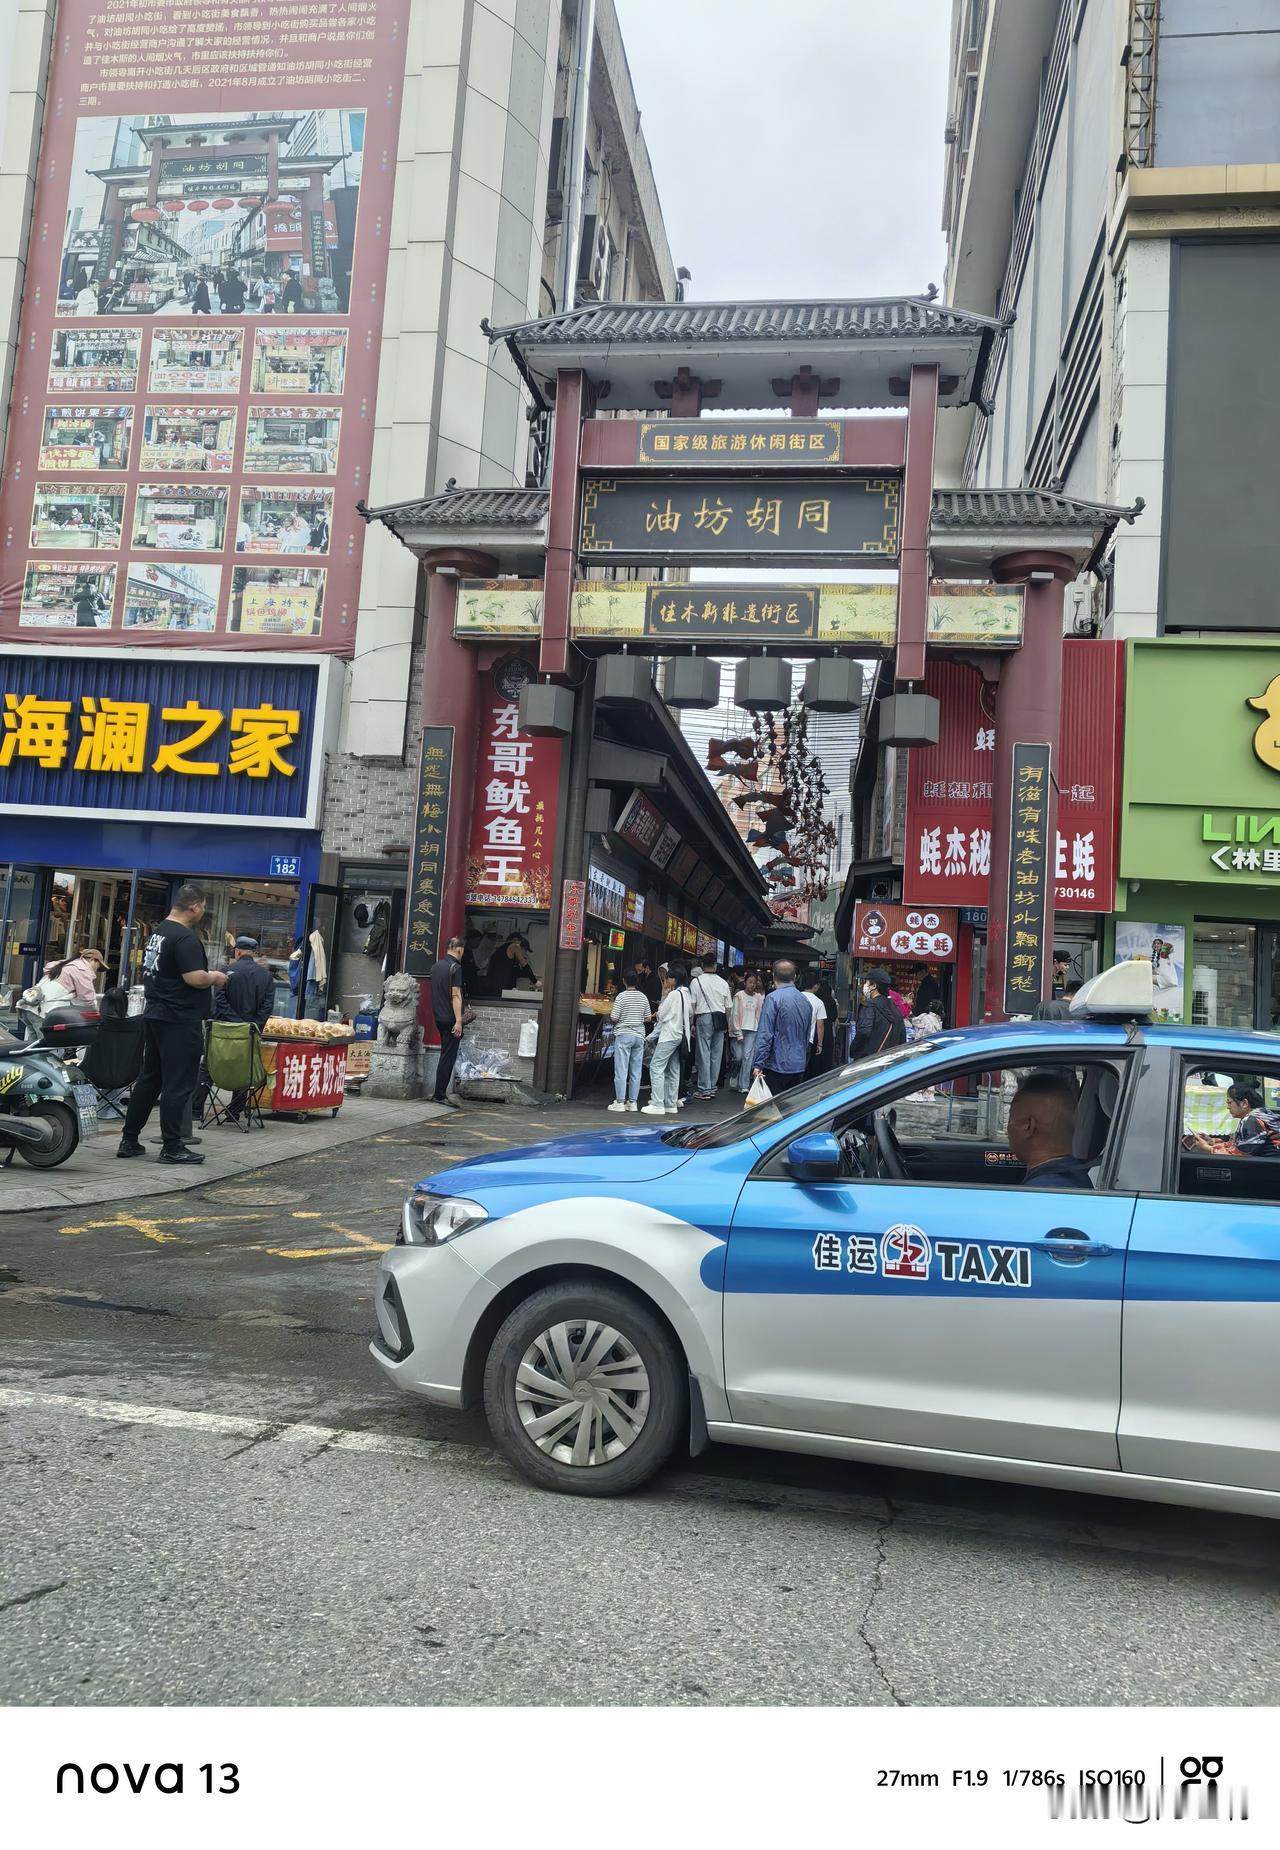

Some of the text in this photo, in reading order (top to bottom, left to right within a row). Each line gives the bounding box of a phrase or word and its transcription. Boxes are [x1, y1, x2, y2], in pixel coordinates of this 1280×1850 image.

[61, 408, 115, 417] 煎饼果子
[653, 433, 825, 451] 国家级旅游休闲街区
[645, 497, 831, 536] 油坊胡同
[659, 600, 802, 625] 佳木斯非遗街区
[0, 693, 301, 778] 海澜之家
[479, 704, 534, 887] 东哥鱿鱼王
[276, 863, 296, 874] 182
[909, 915, 936, 926] 蚝杰
[895, 935, 949, 951] 烤生蚝
[812, 1233, 1032, 1288] 佳运 TAXI
